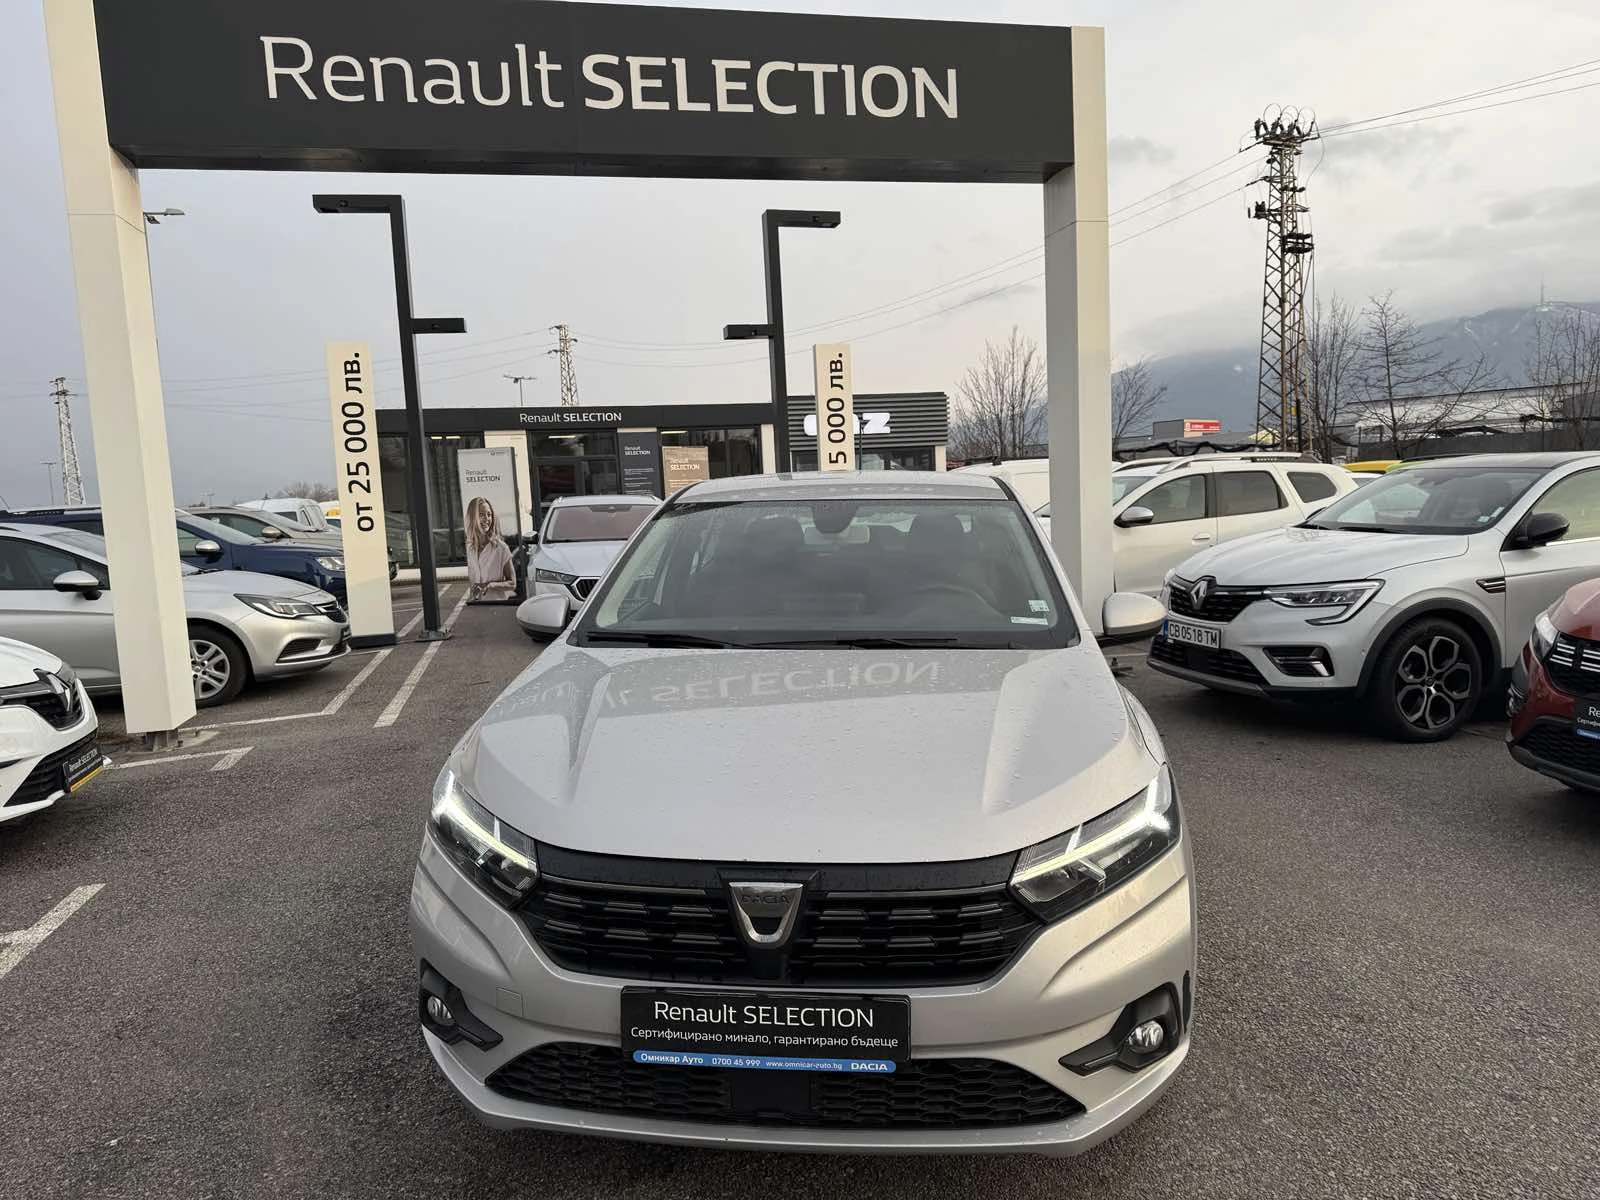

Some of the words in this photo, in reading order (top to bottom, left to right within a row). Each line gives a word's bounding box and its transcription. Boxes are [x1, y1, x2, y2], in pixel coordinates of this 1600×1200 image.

[260, 36, 565, 108] Renault
[582, 54, 958, 118] SELECTION
[344, 353, 363, 394] лв.
[829, 353, 844, 390] лв.
[341, 402, 368, 453] 000
[519, 412, 560, 423] Renault
[563, 412, 622, 422] SELECTION
[826, 398, 846, 443] 000
[347, 461, 371, 494] 25
[466, 475, 501, 483] SELECTION
[356, 502, 374, 531] от
[1169, 623, 1180, 638] CB
[1181, 625, 1203, 643] 0518
[1204, 631, 1217, 646] TM
[742, 895, 790, 904] DACIA
[654, 1001, 737, 1024] Renault
[743, 1006, 873, 1028] SELECTION
[631, 1026, 722, 1042] Сертифицирано
[725, 1033, 772, 1045] минало,
[774, 1034, 848, 1048] гарантирано
[851, 1035, 899, 1049] бъдеще
[640, 1053, 680, 1064] Омникар
[681, 1055, 704, 1065] Ауто
[712, 1057, 732, 1066] 0700
[733, 1058, 743, 1066] 45
[745, 1059, 761, 1067] 999
[850, 1062, 889, 1071] DACIA
